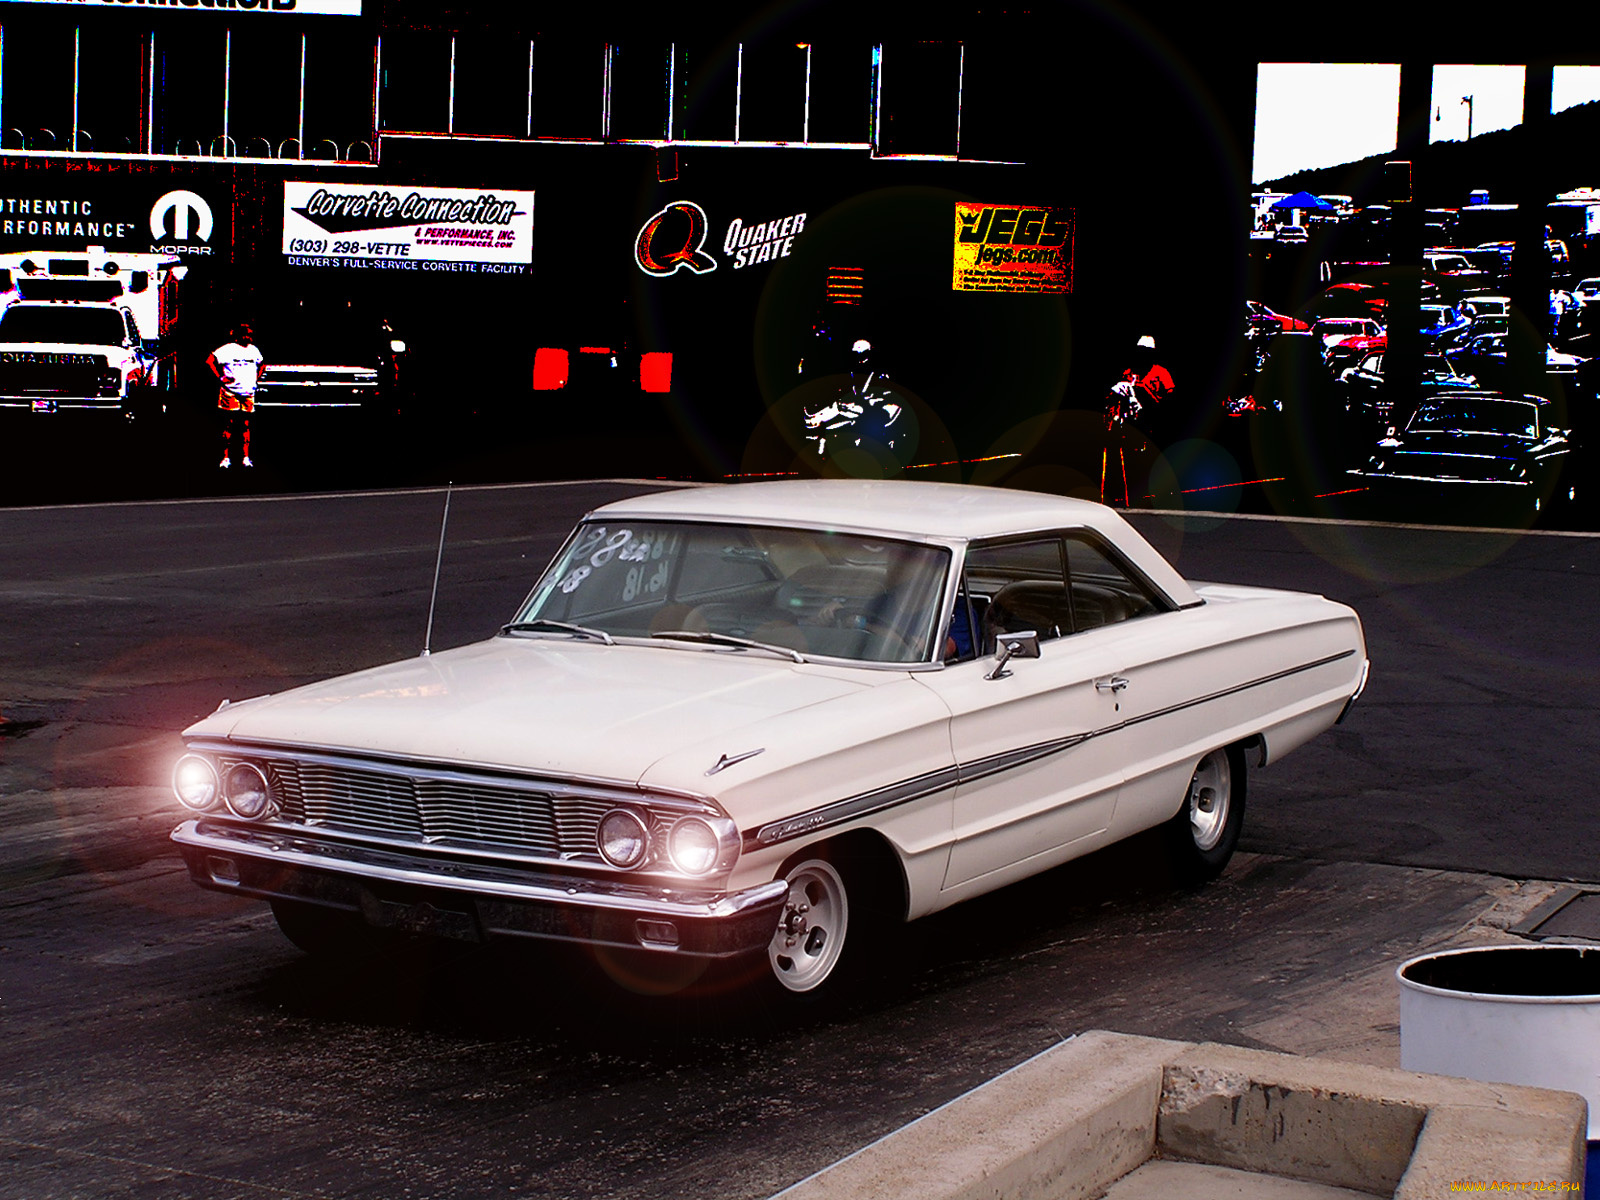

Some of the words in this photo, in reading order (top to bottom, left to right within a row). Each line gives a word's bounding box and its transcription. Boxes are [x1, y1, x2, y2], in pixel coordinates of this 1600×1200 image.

[306, 189, 401, 218] Corvette
[401, 192, 516, 225] Connection
[149, 245, 212, 255] MOPAR
[289, 238, 328, 254] (303)
[332, 241, 411, 256] 298-VETTE
[733, 236, 795, 269] STATE
[288, 256, 340, 267] DENVER'S
[343, 259, 418, 270] FULL-SERVICE
[422, 262, 477, 272] CORVETTE
[482, 264, 525, 274] FACILITY
